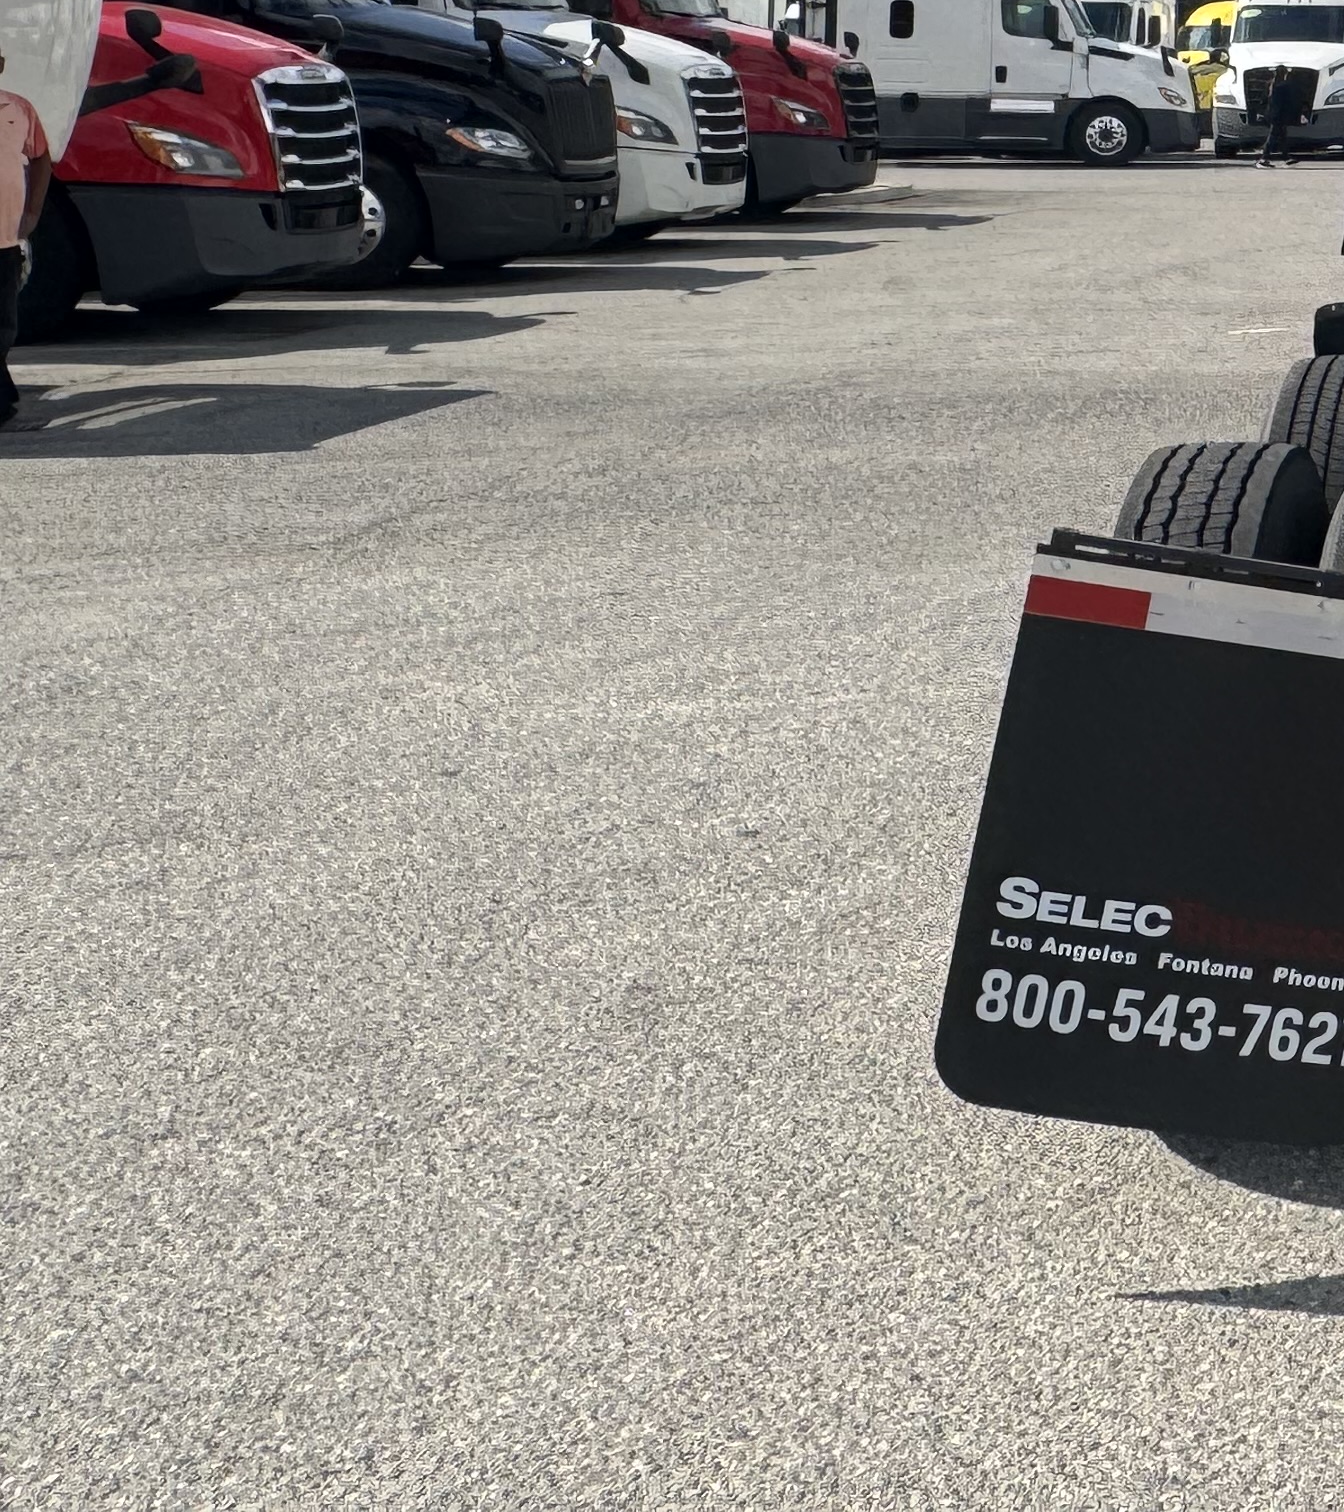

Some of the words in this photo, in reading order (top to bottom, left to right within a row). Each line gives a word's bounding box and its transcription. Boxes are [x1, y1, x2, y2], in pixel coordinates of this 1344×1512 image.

[990, 928, 1033, 952] Los
[1040, 936, 1138, 966] Angeles
[1157, 952, 1254, 981] Fontana
